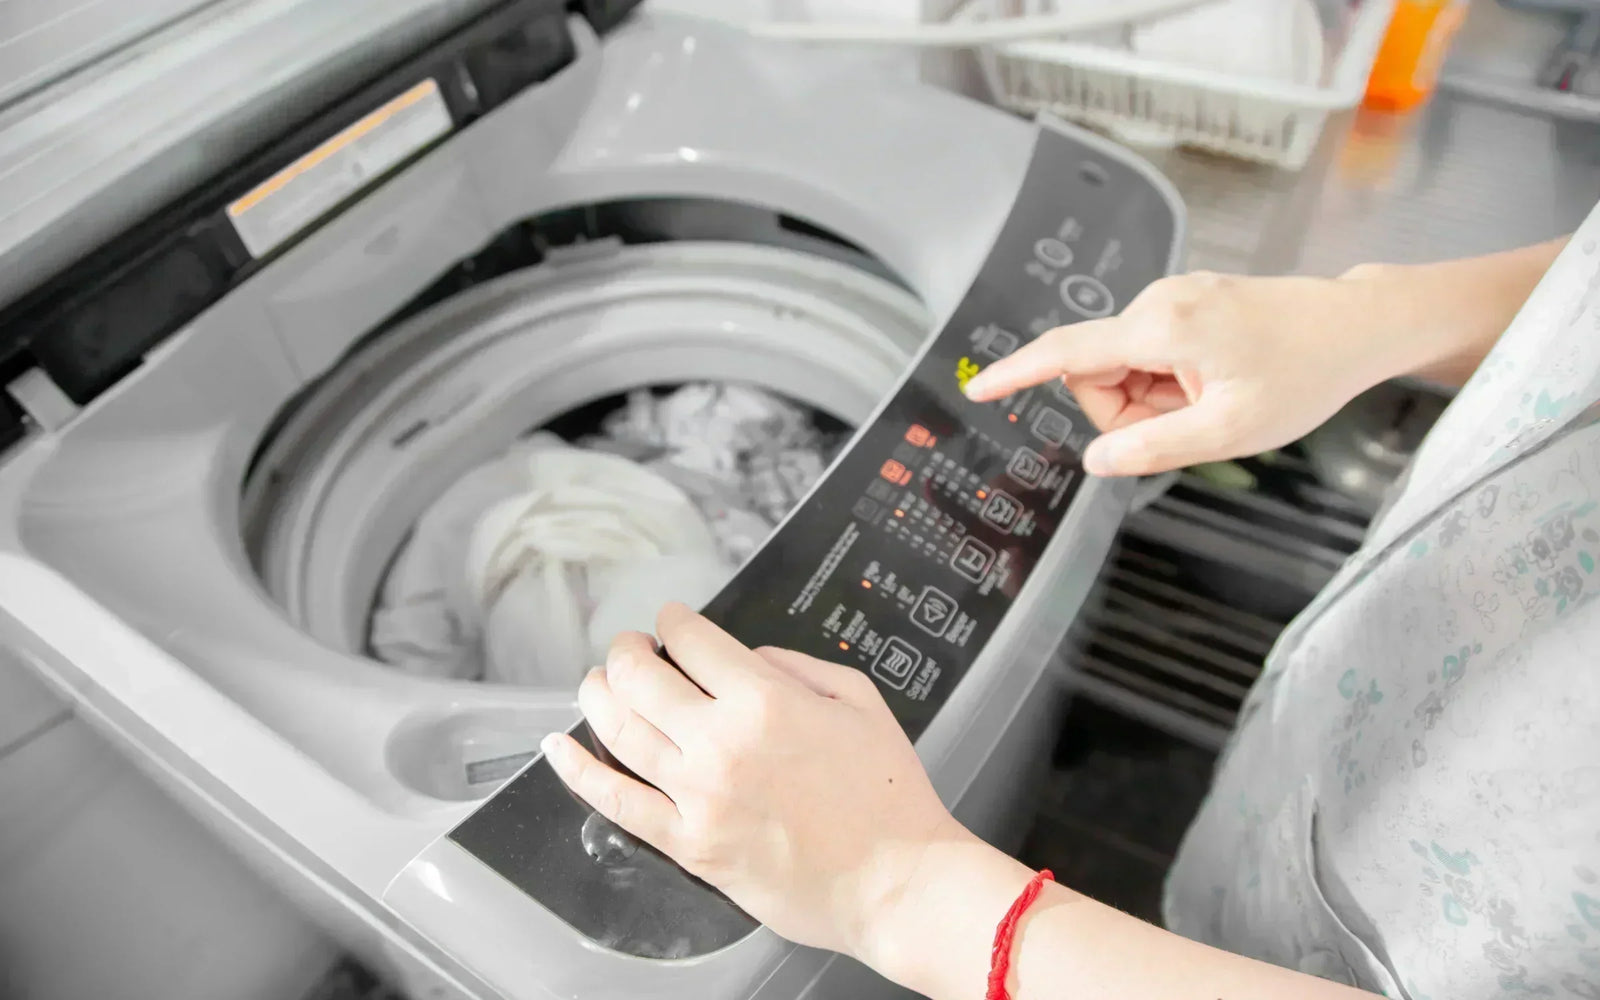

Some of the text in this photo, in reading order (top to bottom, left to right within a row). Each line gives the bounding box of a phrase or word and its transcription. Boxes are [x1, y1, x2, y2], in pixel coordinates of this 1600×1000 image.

[822, 603, 846, 630] Heavy
[841, 610, 864, 640] Normal
[859, 630, 878, 653] Light
[907, 680, 922, 700] Soil
[916, 657, 936, 684] Level
